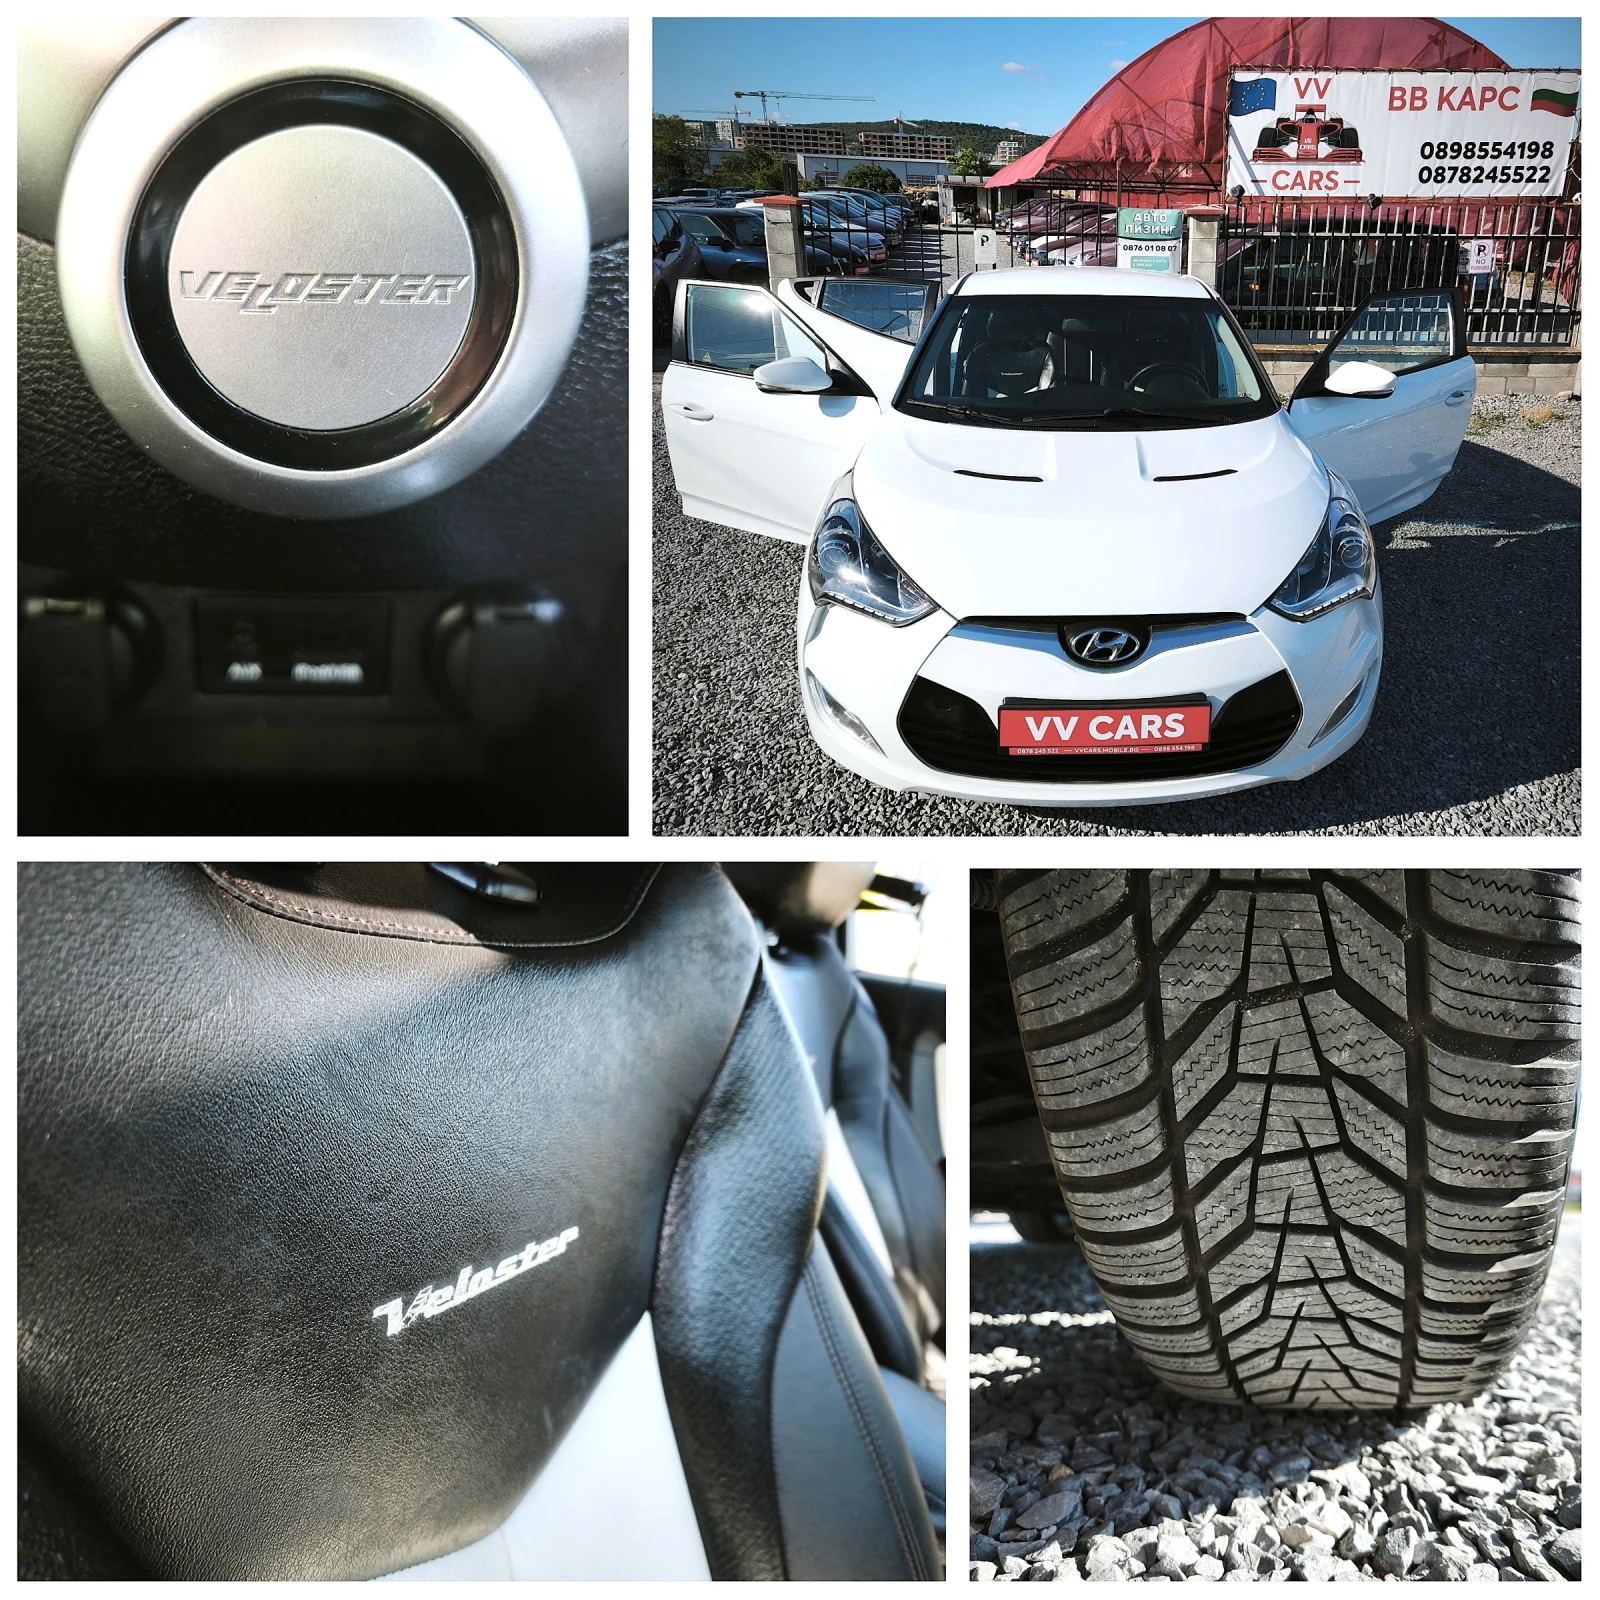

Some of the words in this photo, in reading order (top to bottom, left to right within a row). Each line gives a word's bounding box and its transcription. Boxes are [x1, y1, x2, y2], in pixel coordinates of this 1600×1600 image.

[1294, 77, 1332, 99] VV
[1437, 85, 1521, 112] КАРС
[1420, 141, 1554, 160] 0898554198
[1271, 169, 1339, 191] CARS
[1418, 166, 1551, 184] 0878245522
[1133, 213, 1167, 223] АВТО
[1124, 224, 1176, 235] ЛИЗИНГ
[1122, 244, 1143, 252] 0876
[1144, 244, 1154, 252] 01
[180, 271, 470, 314] VELOSTER
[1025, 716, 1079, 741] VV
[1088, 713, 1185, 741] CARS
[372, 1226, 579, 1337] Veloster
